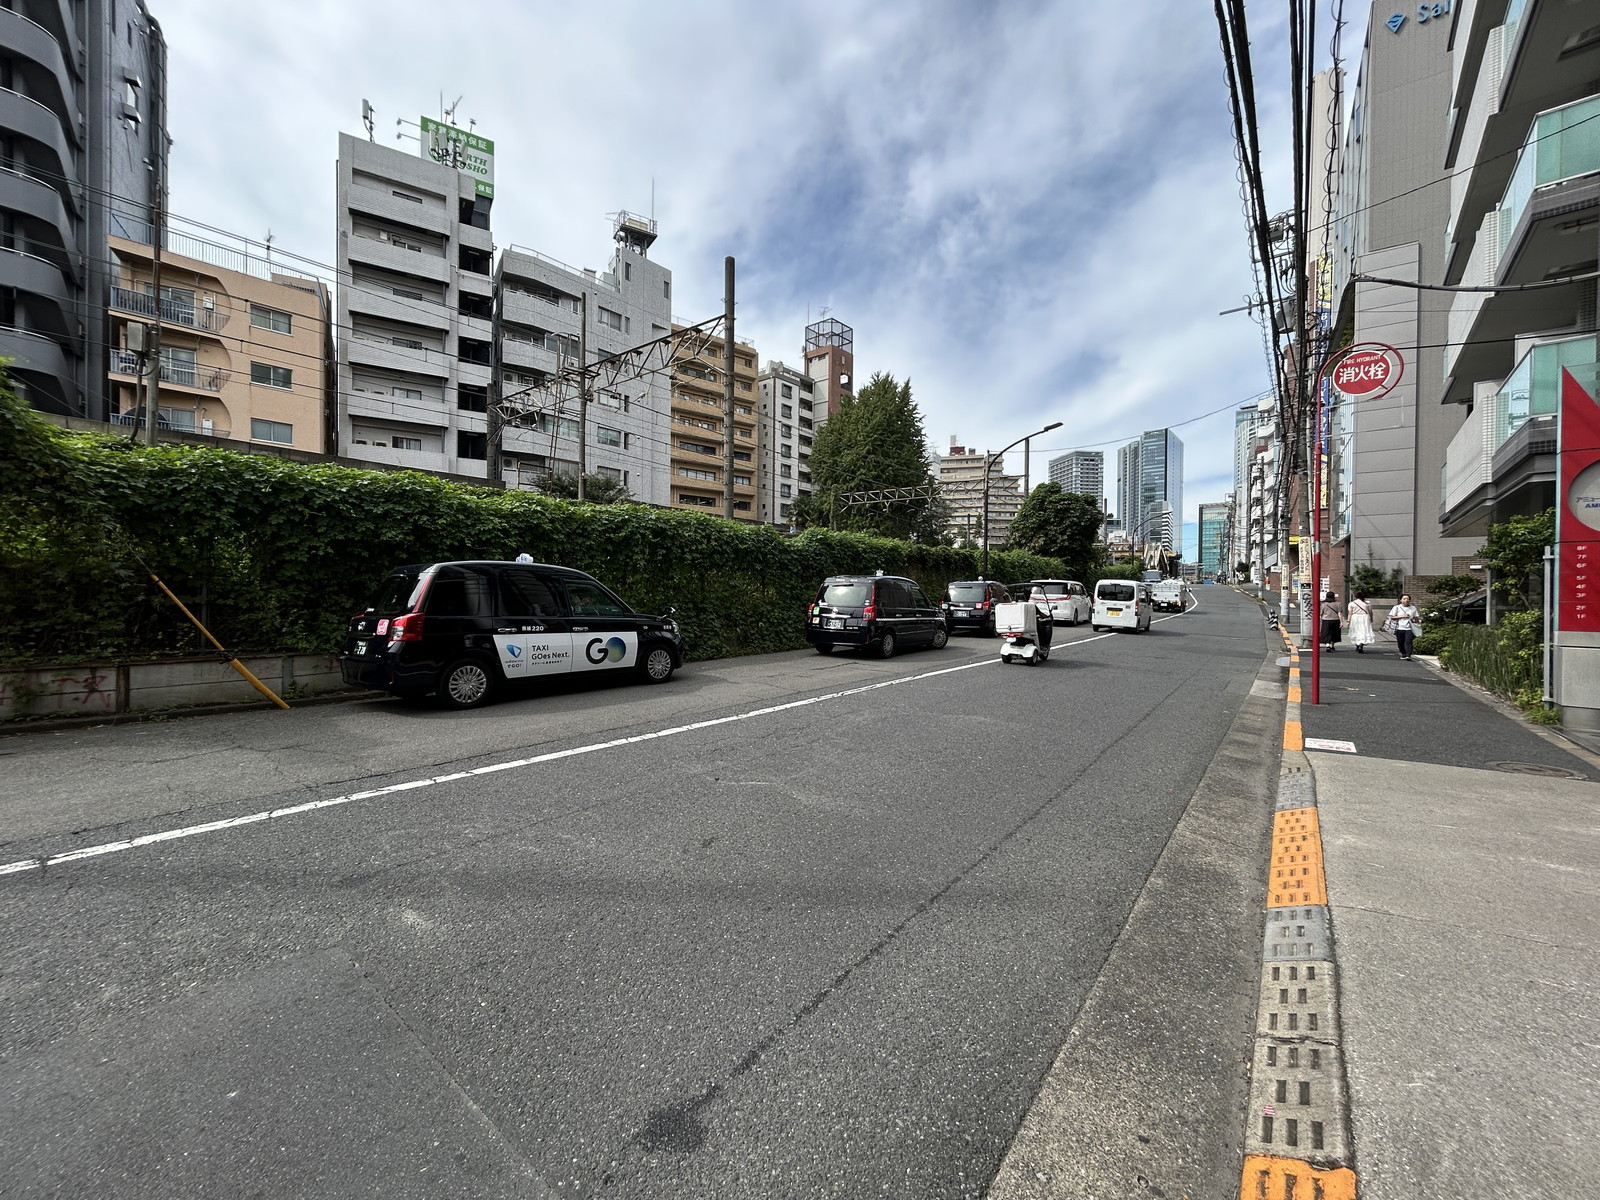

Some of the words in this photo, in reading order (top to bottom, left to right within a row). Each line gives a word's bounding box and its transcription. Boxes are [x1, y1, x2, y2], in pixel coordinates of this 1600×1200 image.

[466, 153, 488, 167] RTH
[466, 163, 488, 175] SHO
[475, 184, 493, 195] 保証
[1356, 355, 1381, 363] HYDRANT
[1338, 362, 1387, 385] 消火栓
[552, 651, 570, 659] Next.
[585, 637, 627, 665] GO
